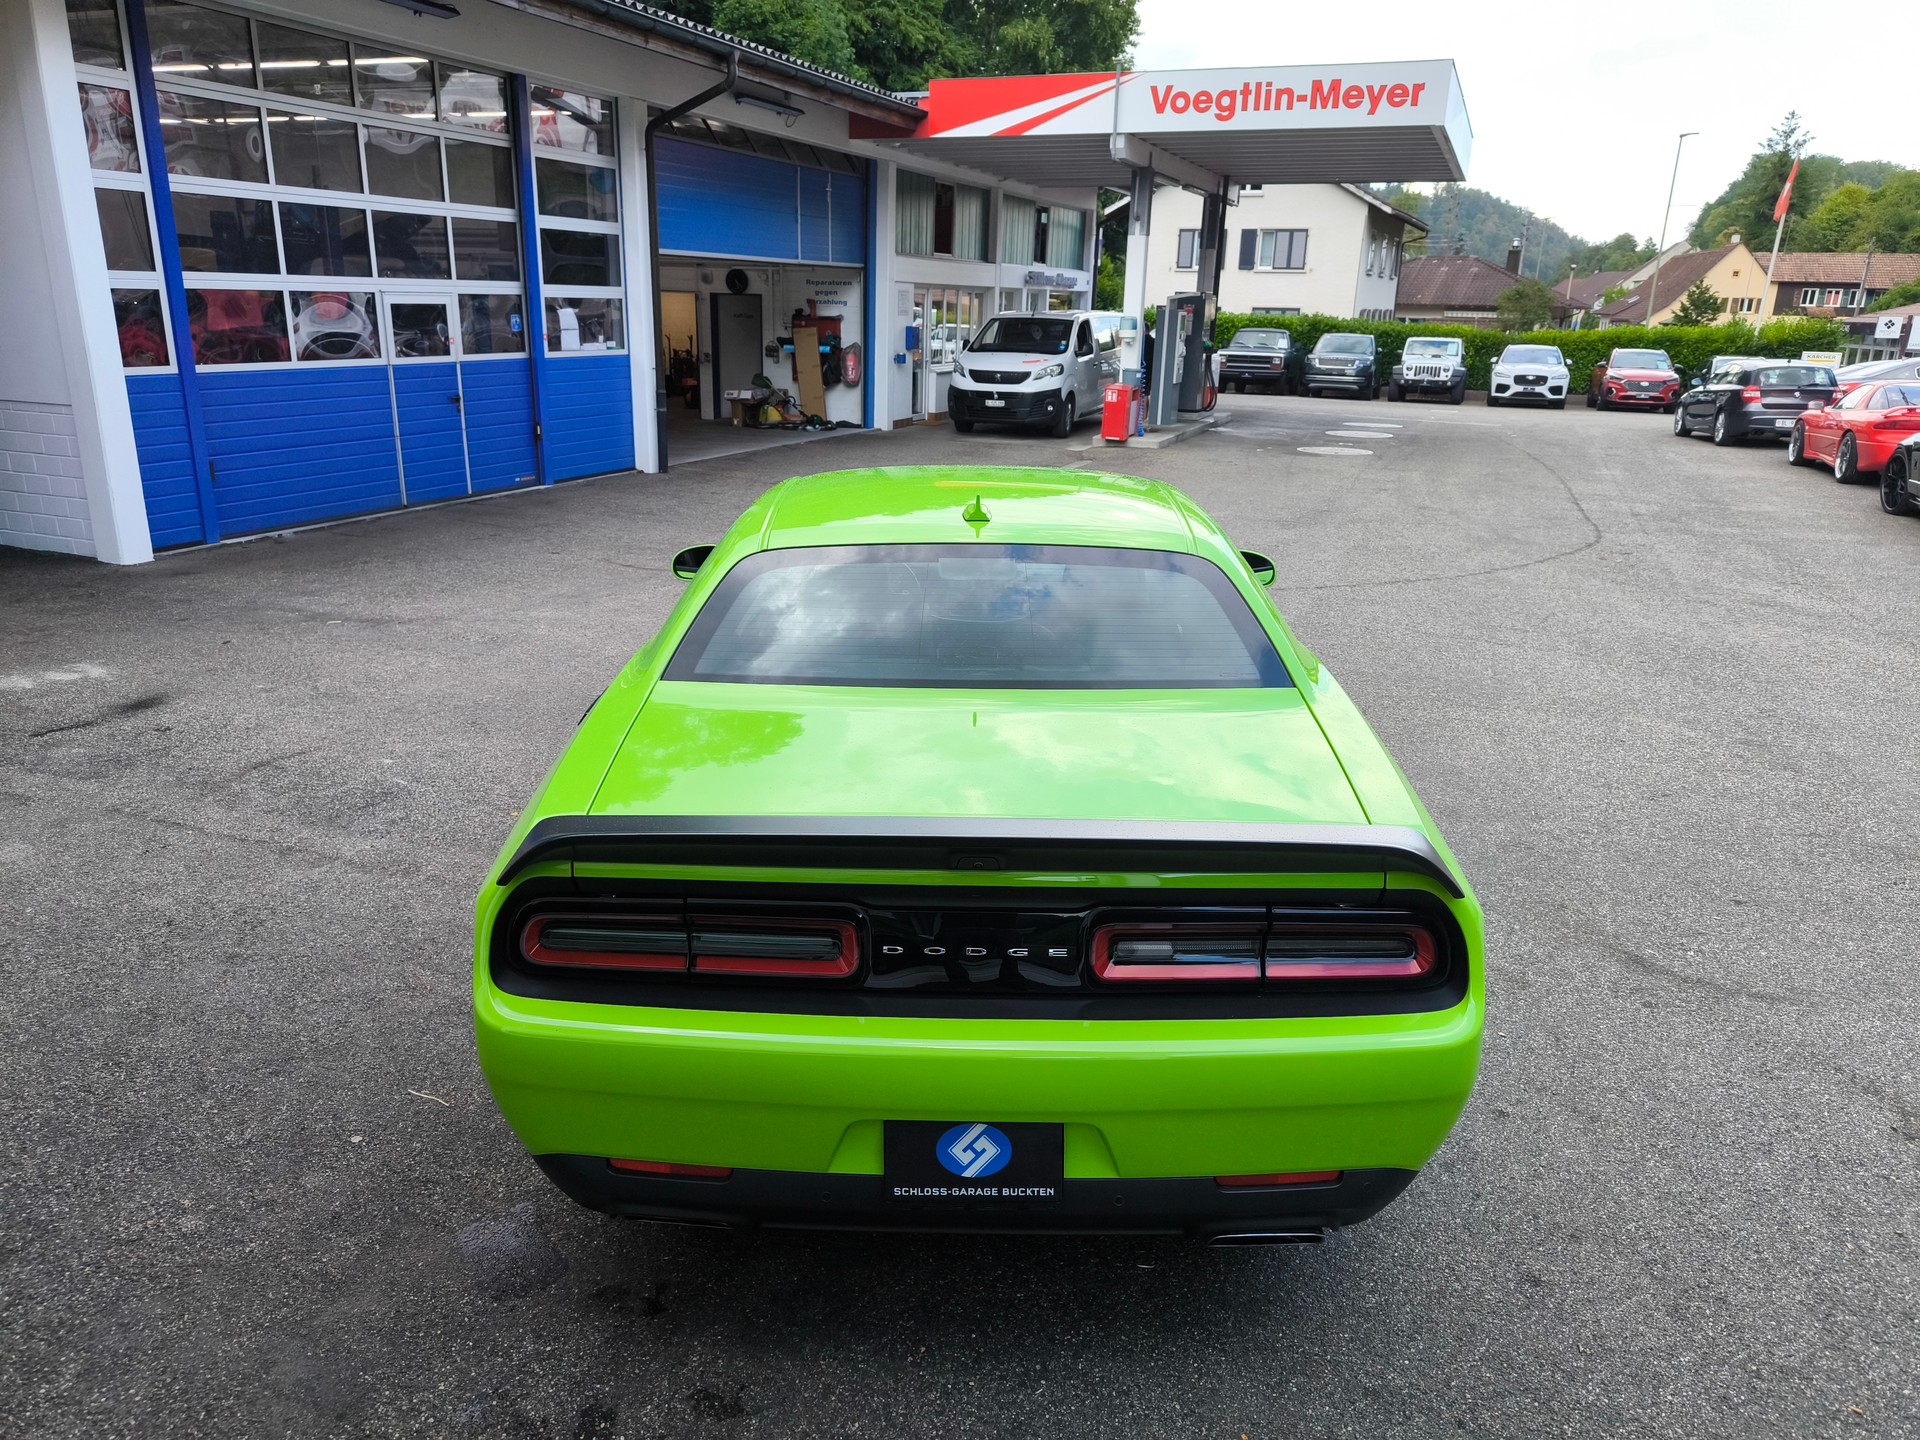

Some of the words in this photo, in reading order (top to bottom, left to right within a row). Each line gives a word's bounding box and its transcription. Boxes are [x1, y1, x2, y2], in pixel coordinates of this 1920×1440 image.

[1150, 79, 1425, 121] Voegtlin-Meyer
[805, 279, 853, 287] Reparaturen
[883, 946, 1067, 957] DODGE
[893, 1187, 999, 1196] SCHLOSS-GARAGE
[1002, 1187, 1055, 1196] BUCKTEN
